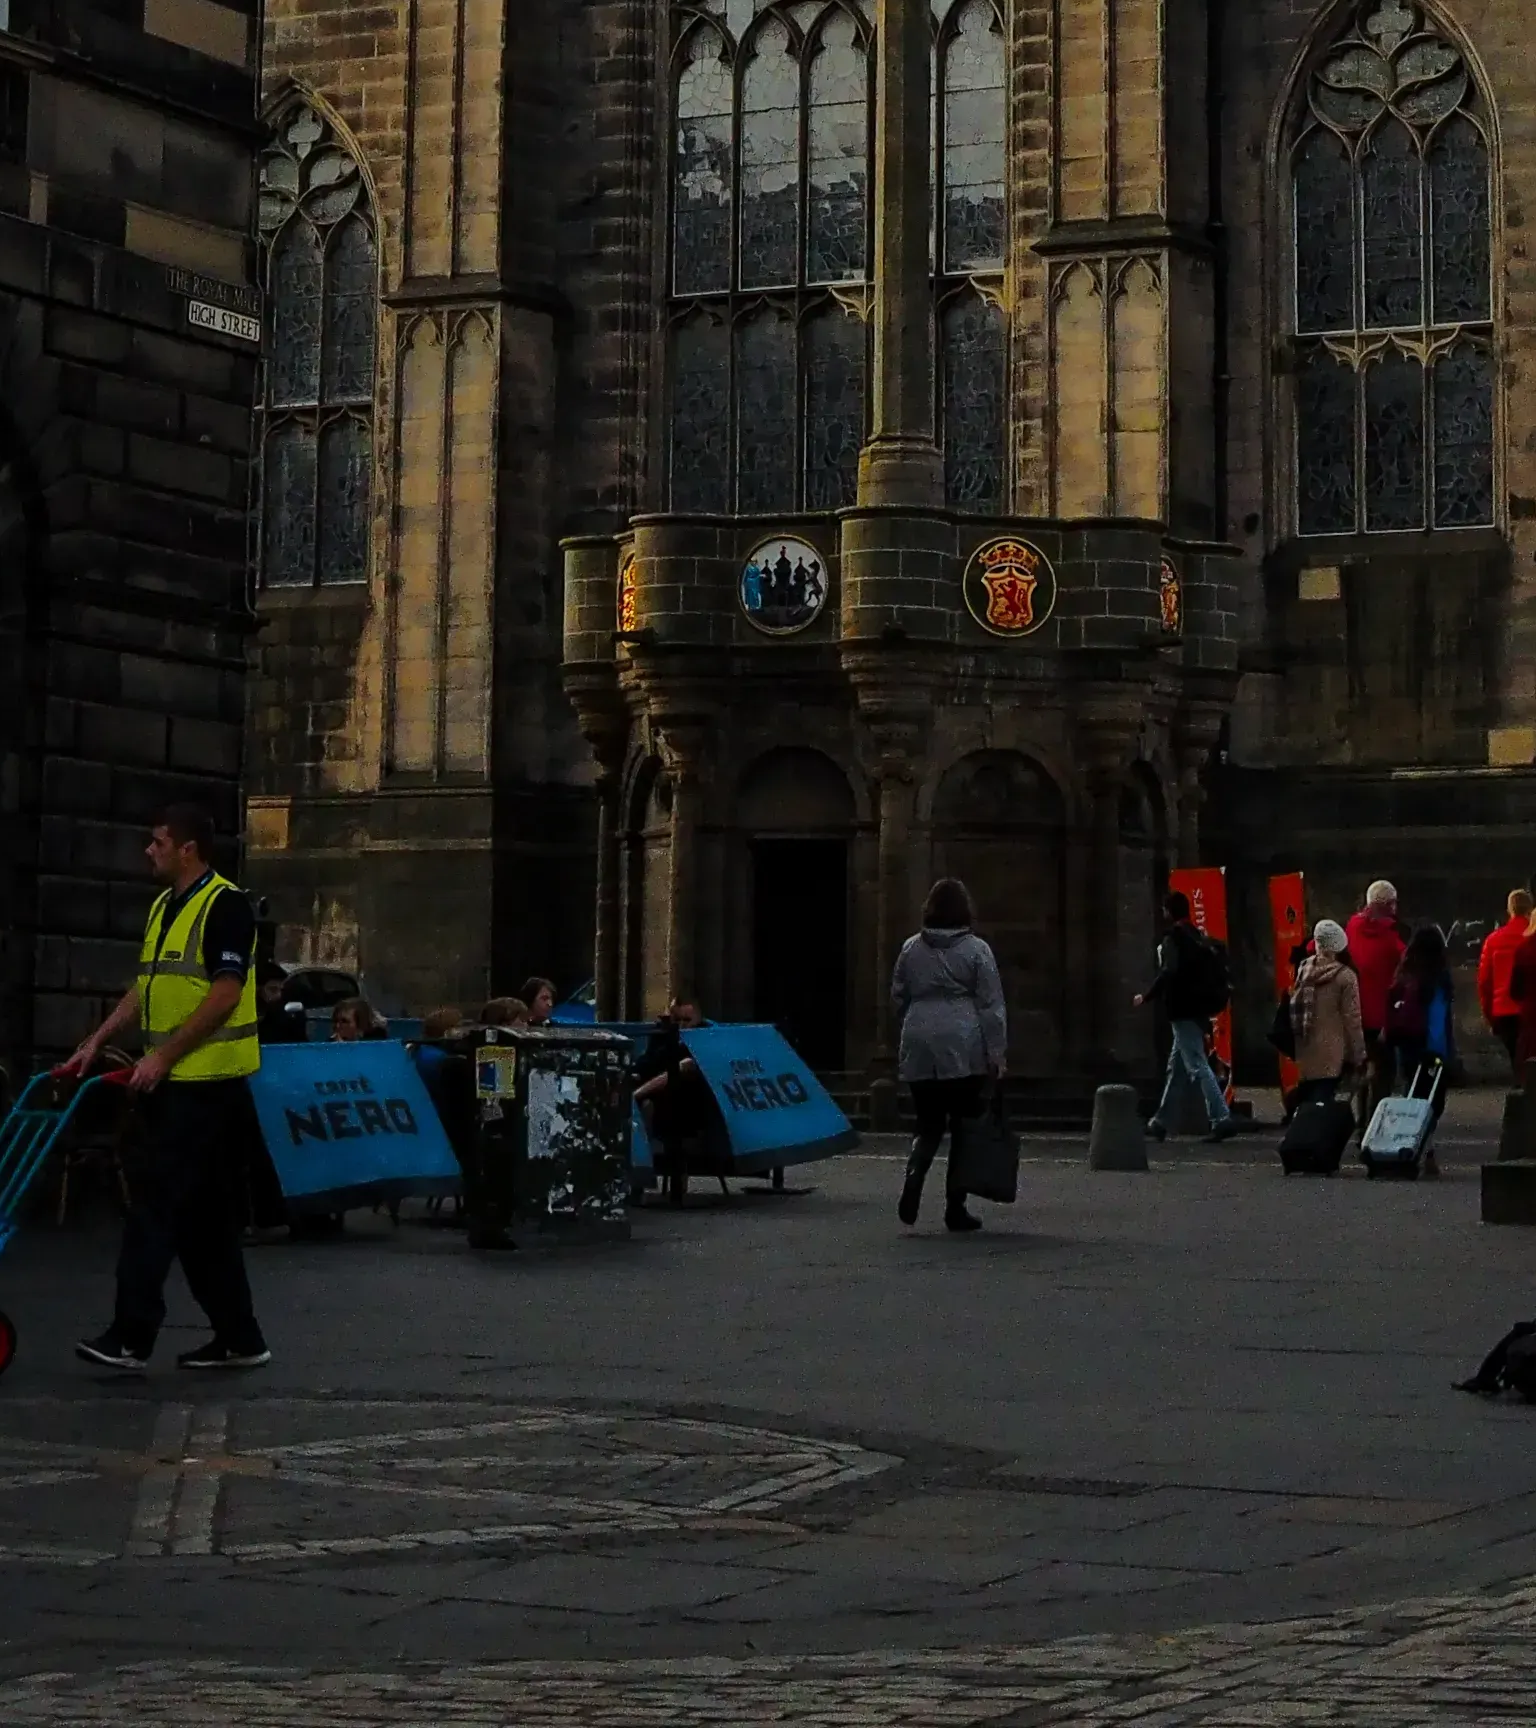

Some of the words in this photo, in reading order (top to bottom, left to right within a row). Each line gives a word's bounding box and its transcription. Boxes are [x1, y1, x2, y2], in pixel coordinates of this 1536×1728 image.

[193, 275, 228, 304] ROYAL
[233, 287, 261, 312] MILE
[190, 303, 216, 325] HIGH
[221, 312, 259, 339] STREET
[721, 1073, 809, 1113] NERO
[283, 1097, 419, 1146] NERO
